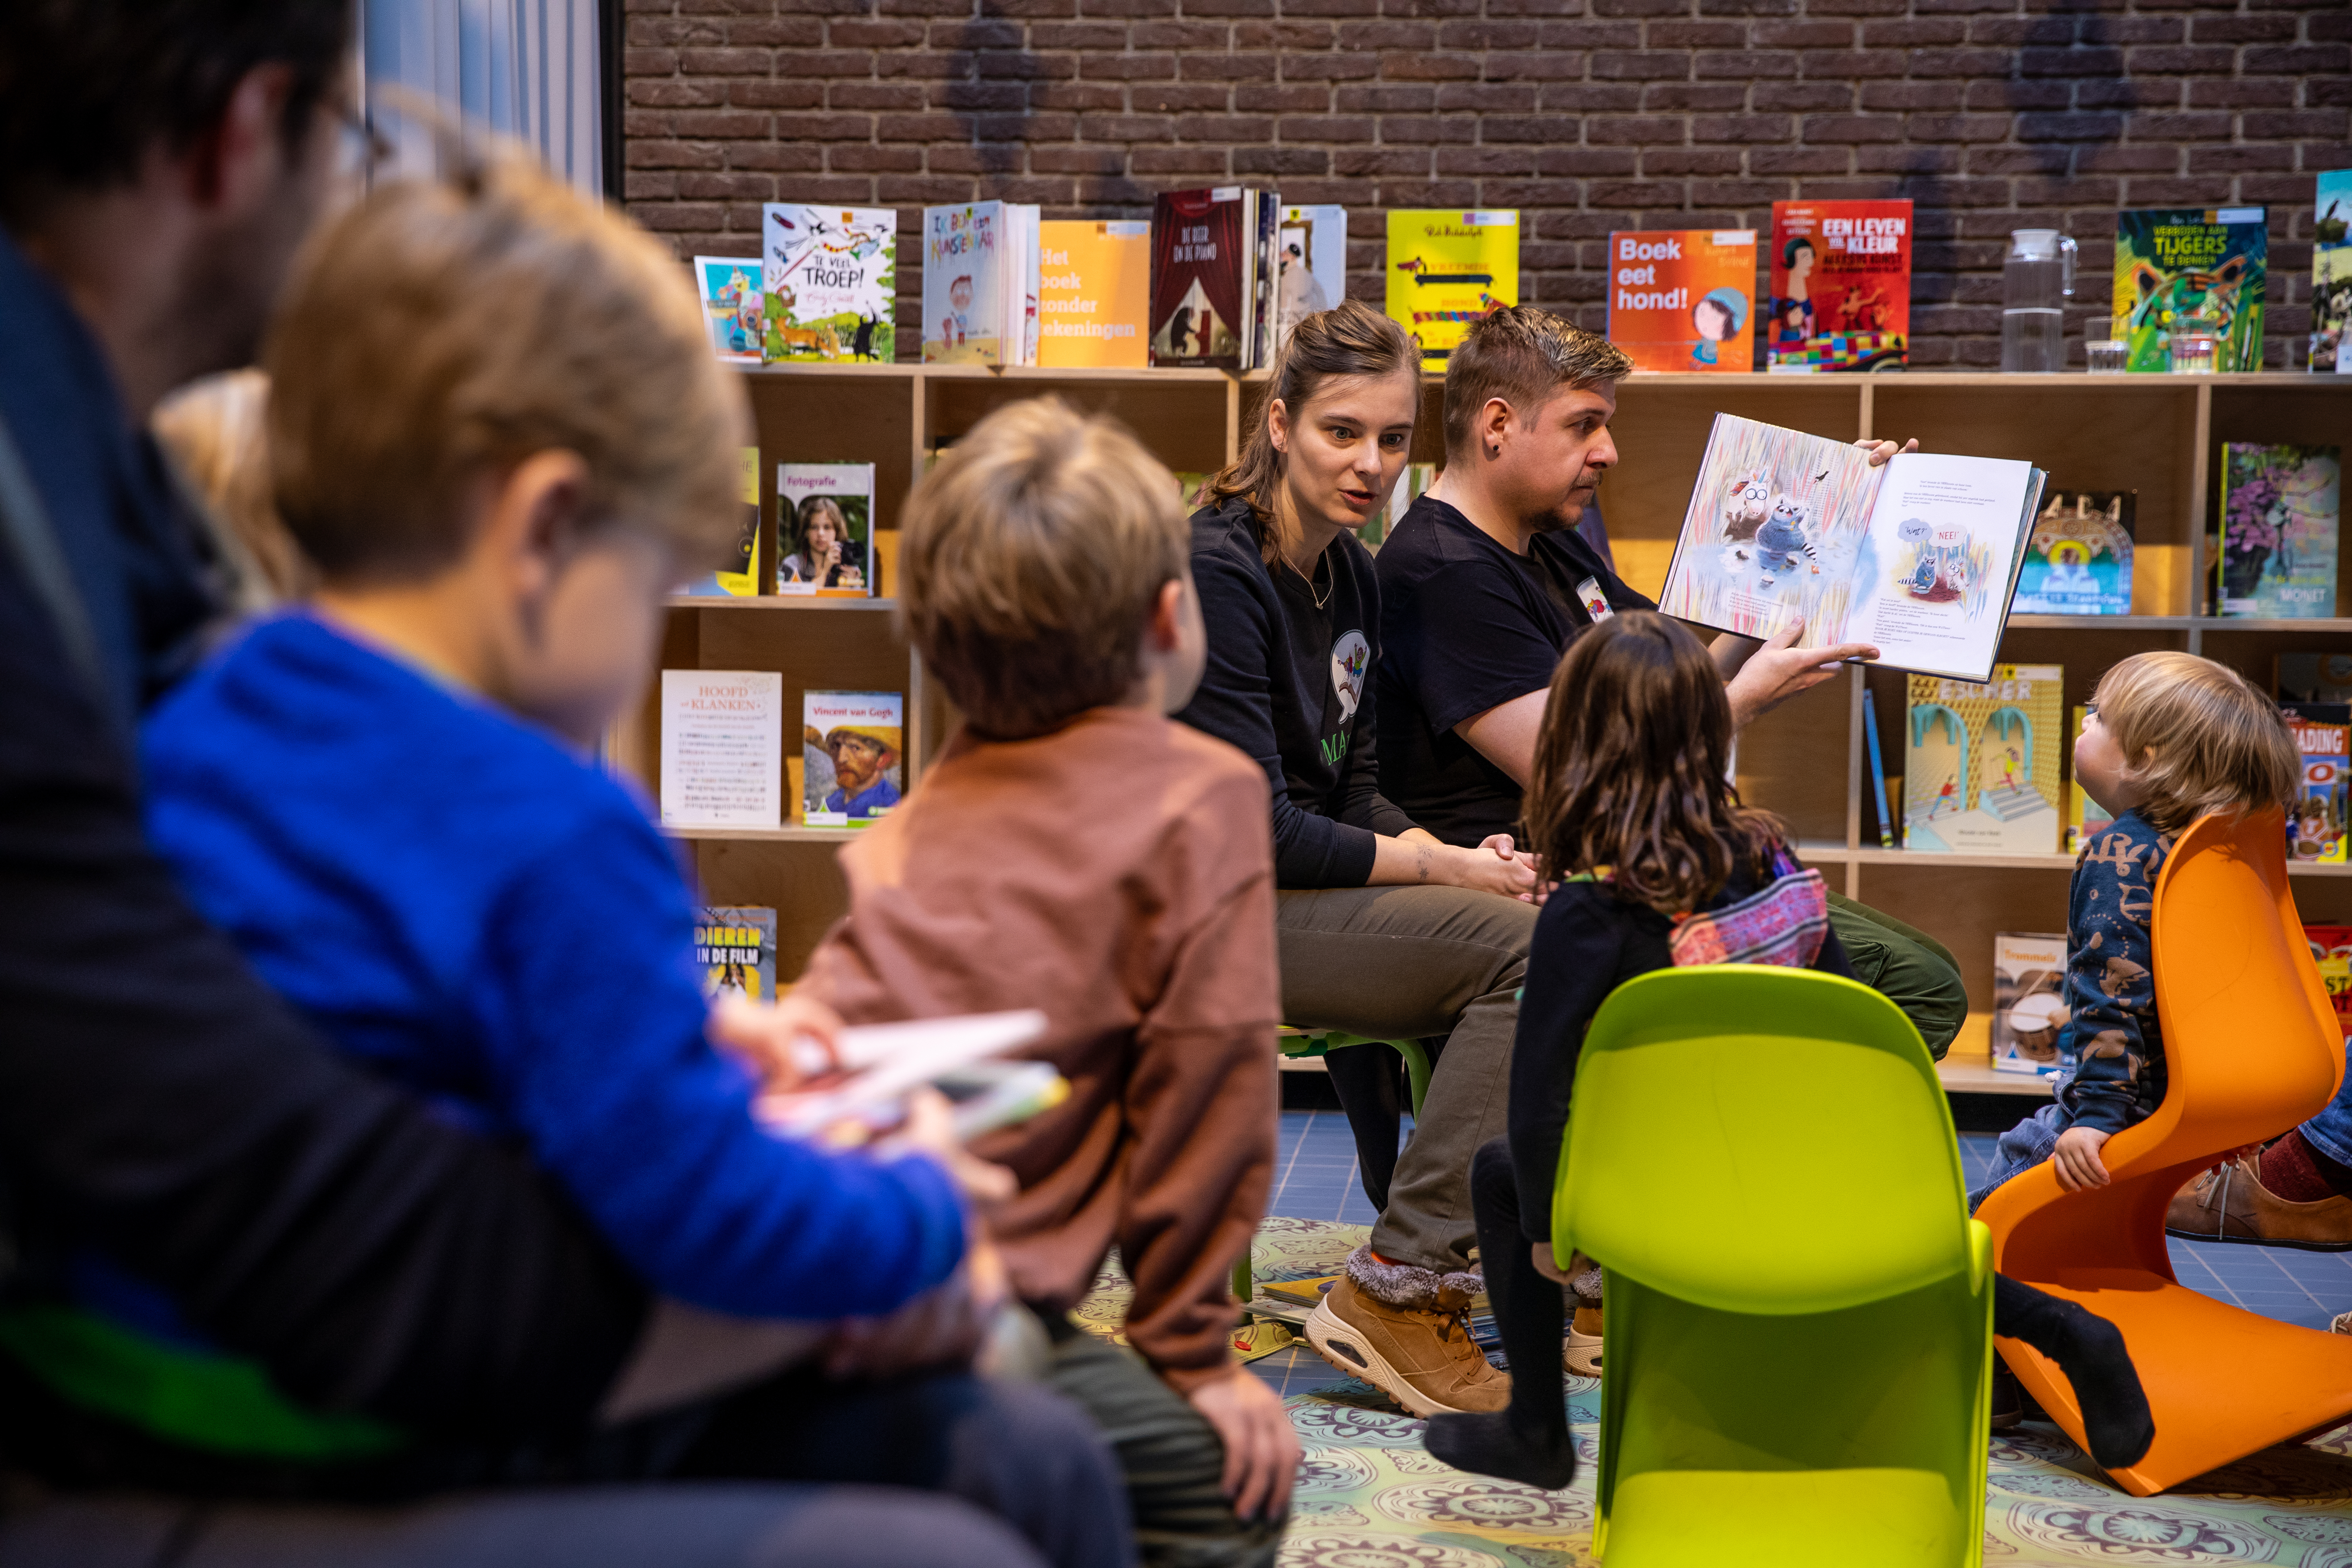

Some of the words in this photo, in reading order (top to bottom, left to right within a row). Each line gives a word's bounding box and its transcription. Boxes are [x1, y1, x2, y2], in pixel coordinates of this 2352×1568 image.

[1822, 218, 1853, 238] EEN
[1855, 218, 1906, 237] LEVEN
[1619, 239, 1681, 260] Boek
[1847, 235, 1898, 254] KLEUR
[2153, 235, 2227, 255] TIJGERS
[802, 267, 865, 289] TROEP!
[1618, 264, 1655, 286] eet
[1617, 288, 1688, 310] hond!
[1040, 319, 1135, 340] ekeningen
[787, 476, 837, 489] Fotografie
[1937, 531, 1959, 540] 'NEE!'
[699, 686, 748, 698] HOOFD
[1939, 679, 2032, 700] ESCHER
[813, 707, 847, 715] Vincent
[869, 707, 893, 720] Gogh
[694, 926, 761, 947] DIEREN
[697, 947, 709, 964] IN
[712, 947, 728, 964] DE
[729, 947, 759, 965] FILM
[2325, 976, 2350, 993] ST
